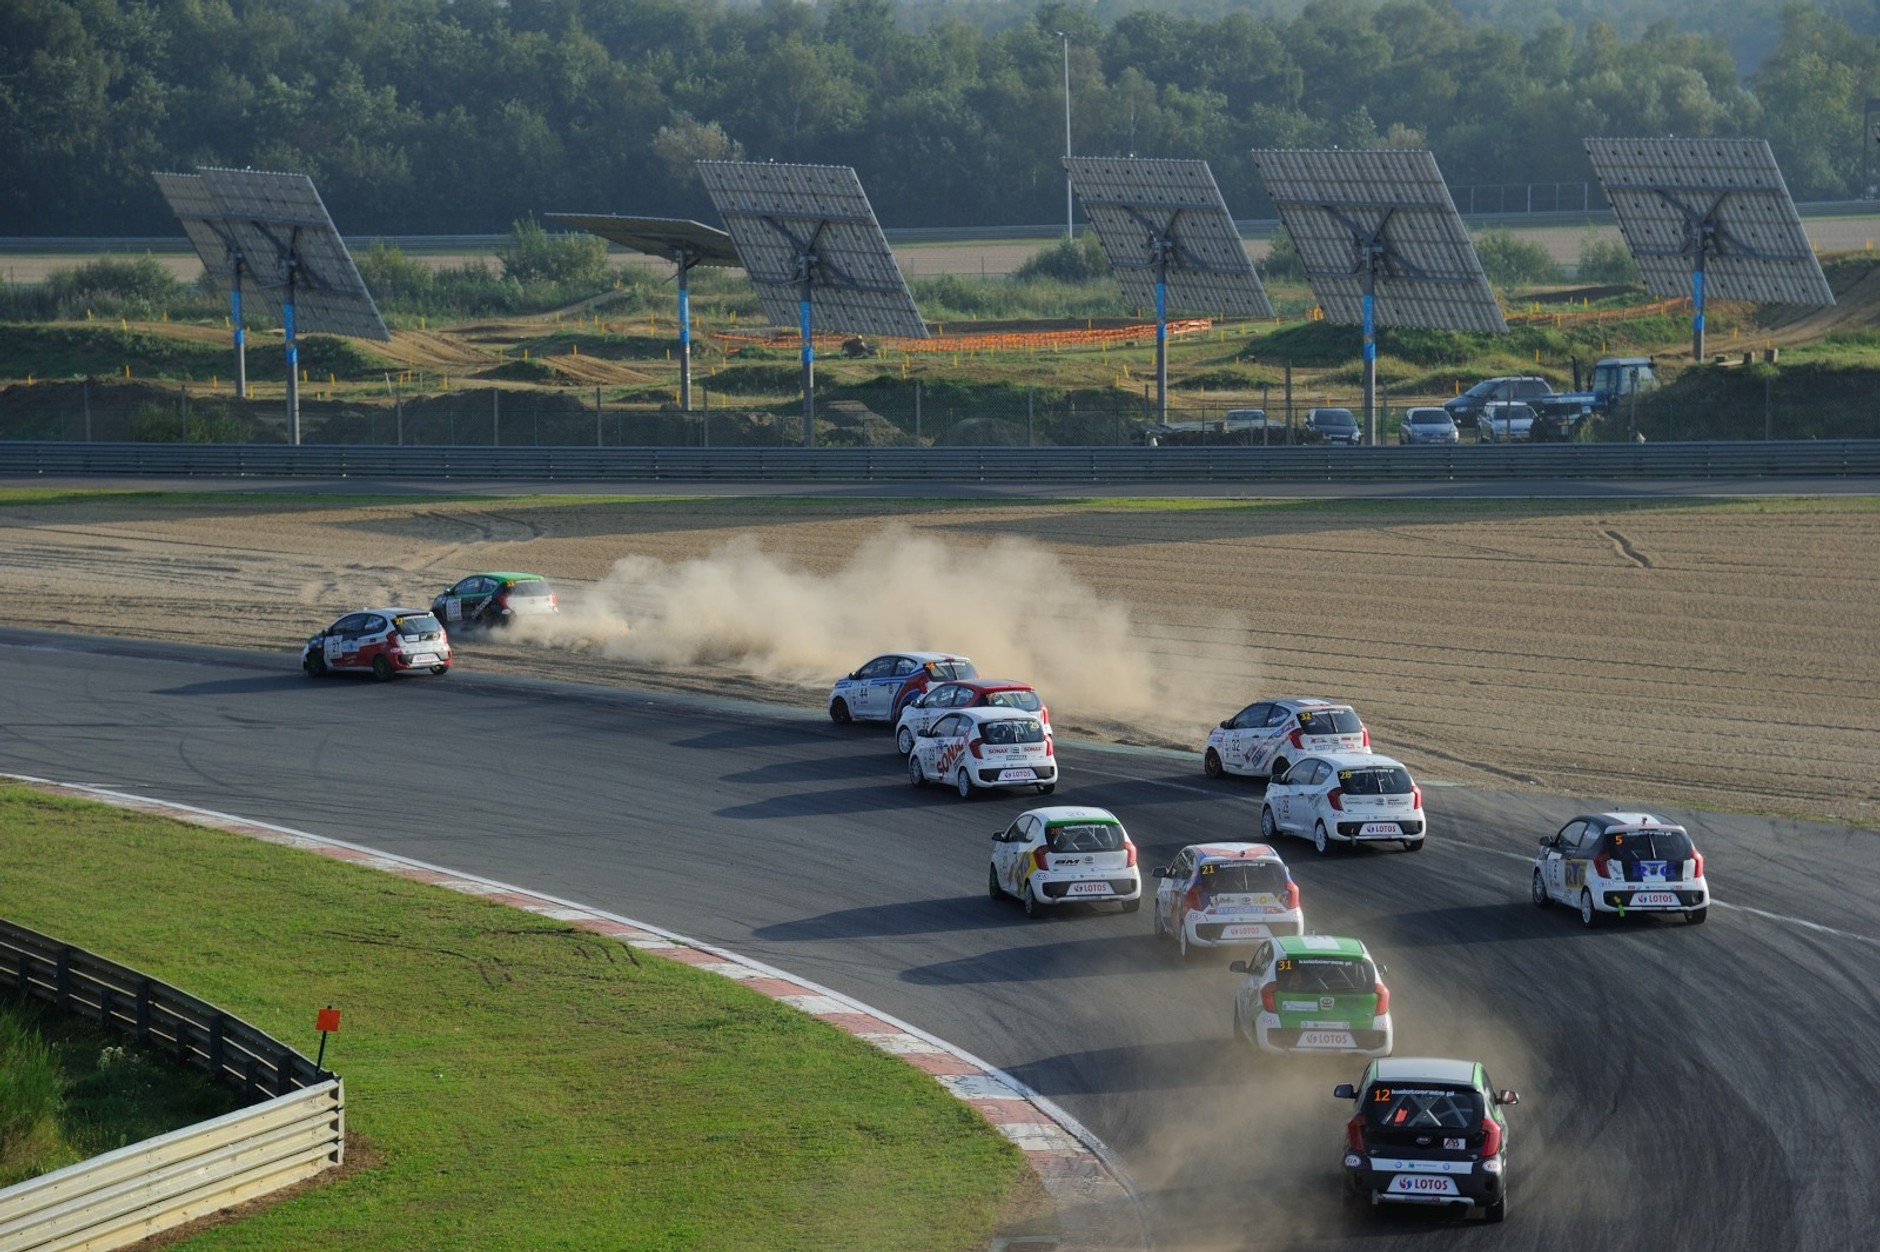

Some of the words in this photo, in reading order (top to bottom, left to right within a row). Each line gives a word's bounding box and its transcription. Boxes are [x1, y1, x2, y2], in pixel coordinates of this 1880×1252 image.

[333, 642, 340, 653] 27
[860, 687, 868, 699] 44
[1232, 739, 1240, 751] 32
[1616, 835, 1623, 845] 5
[1202, 865, 1215, 874] 21
[1084, 884, 1106, 892] LOTOS
[1278, 960, 1293, 971] 31
[1320, 1034, 1347, 1044] LOTOS
[1375, 1088, 1391, 1102] 12
[1415, 1178, 1448, 1190] LOTOS
